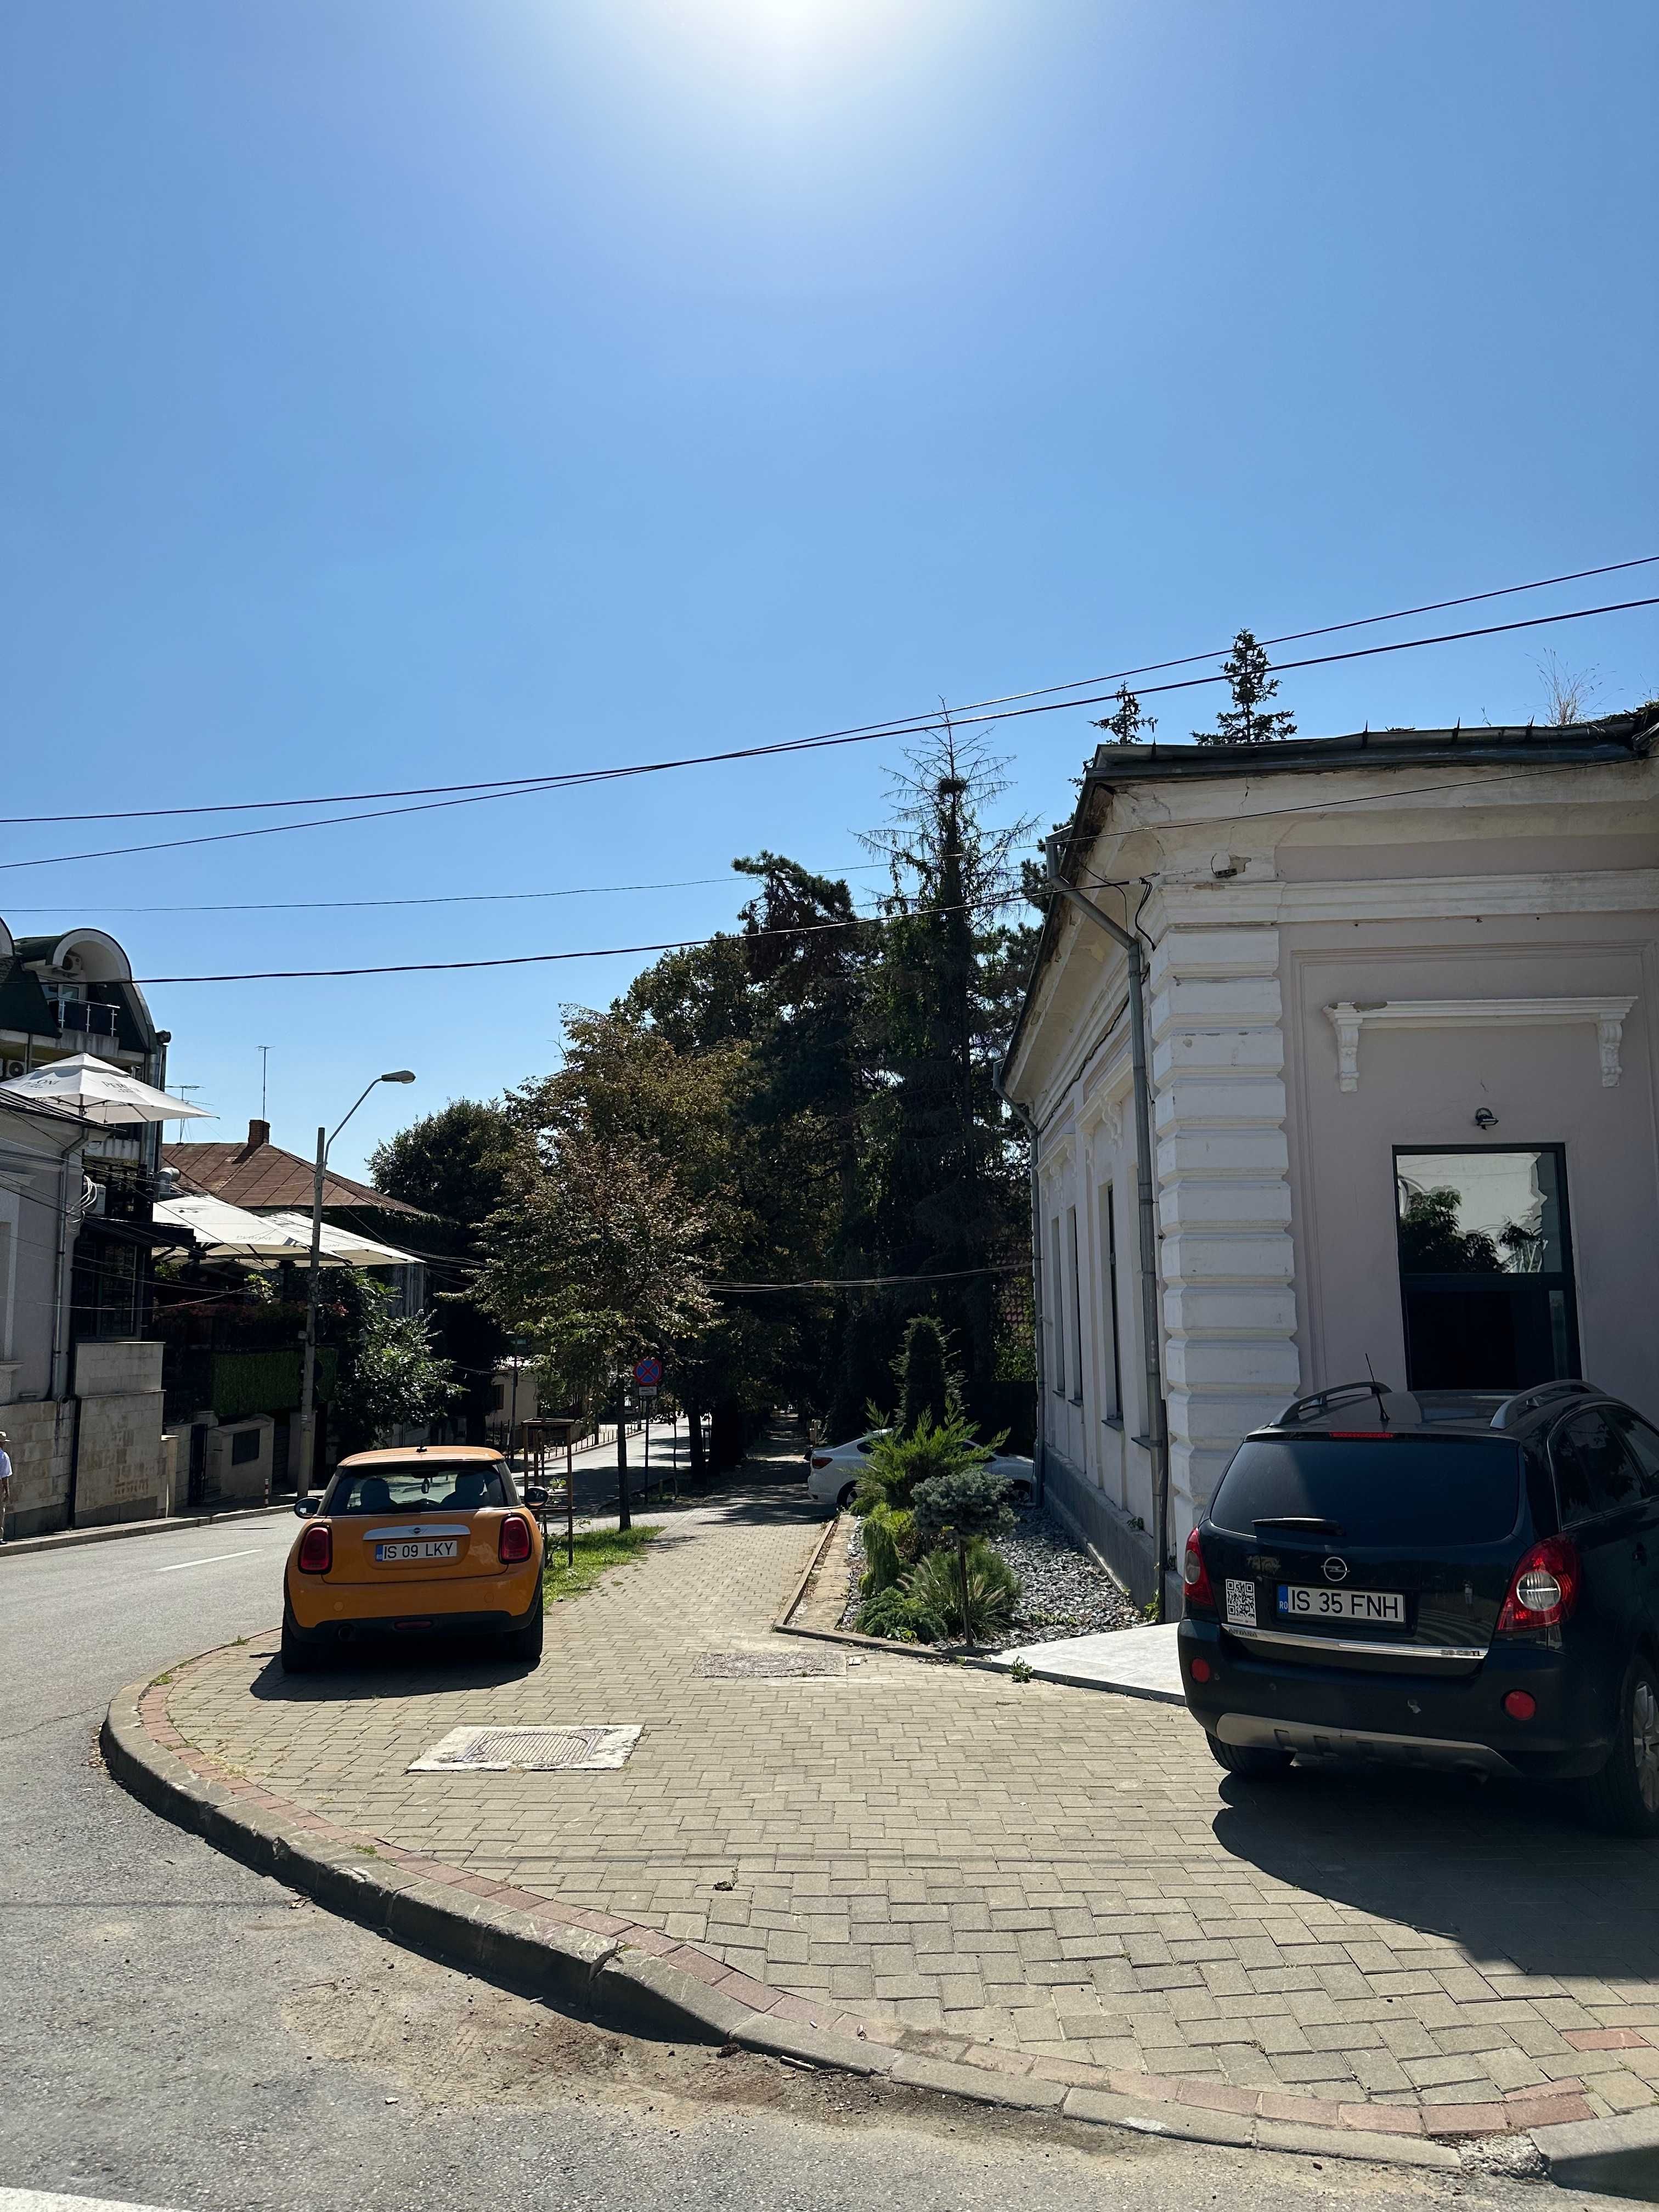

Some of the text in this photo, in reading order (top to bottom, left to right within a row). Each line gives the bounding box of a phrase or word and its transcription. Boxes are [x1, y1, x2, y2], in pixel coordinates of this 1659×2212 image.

[384, 1542, 454, 1559] IS 09 LKY
[1279, 1601, 1288, 1610] RO
[1292, 1590, 1398, 1619] IS 35 FNH
